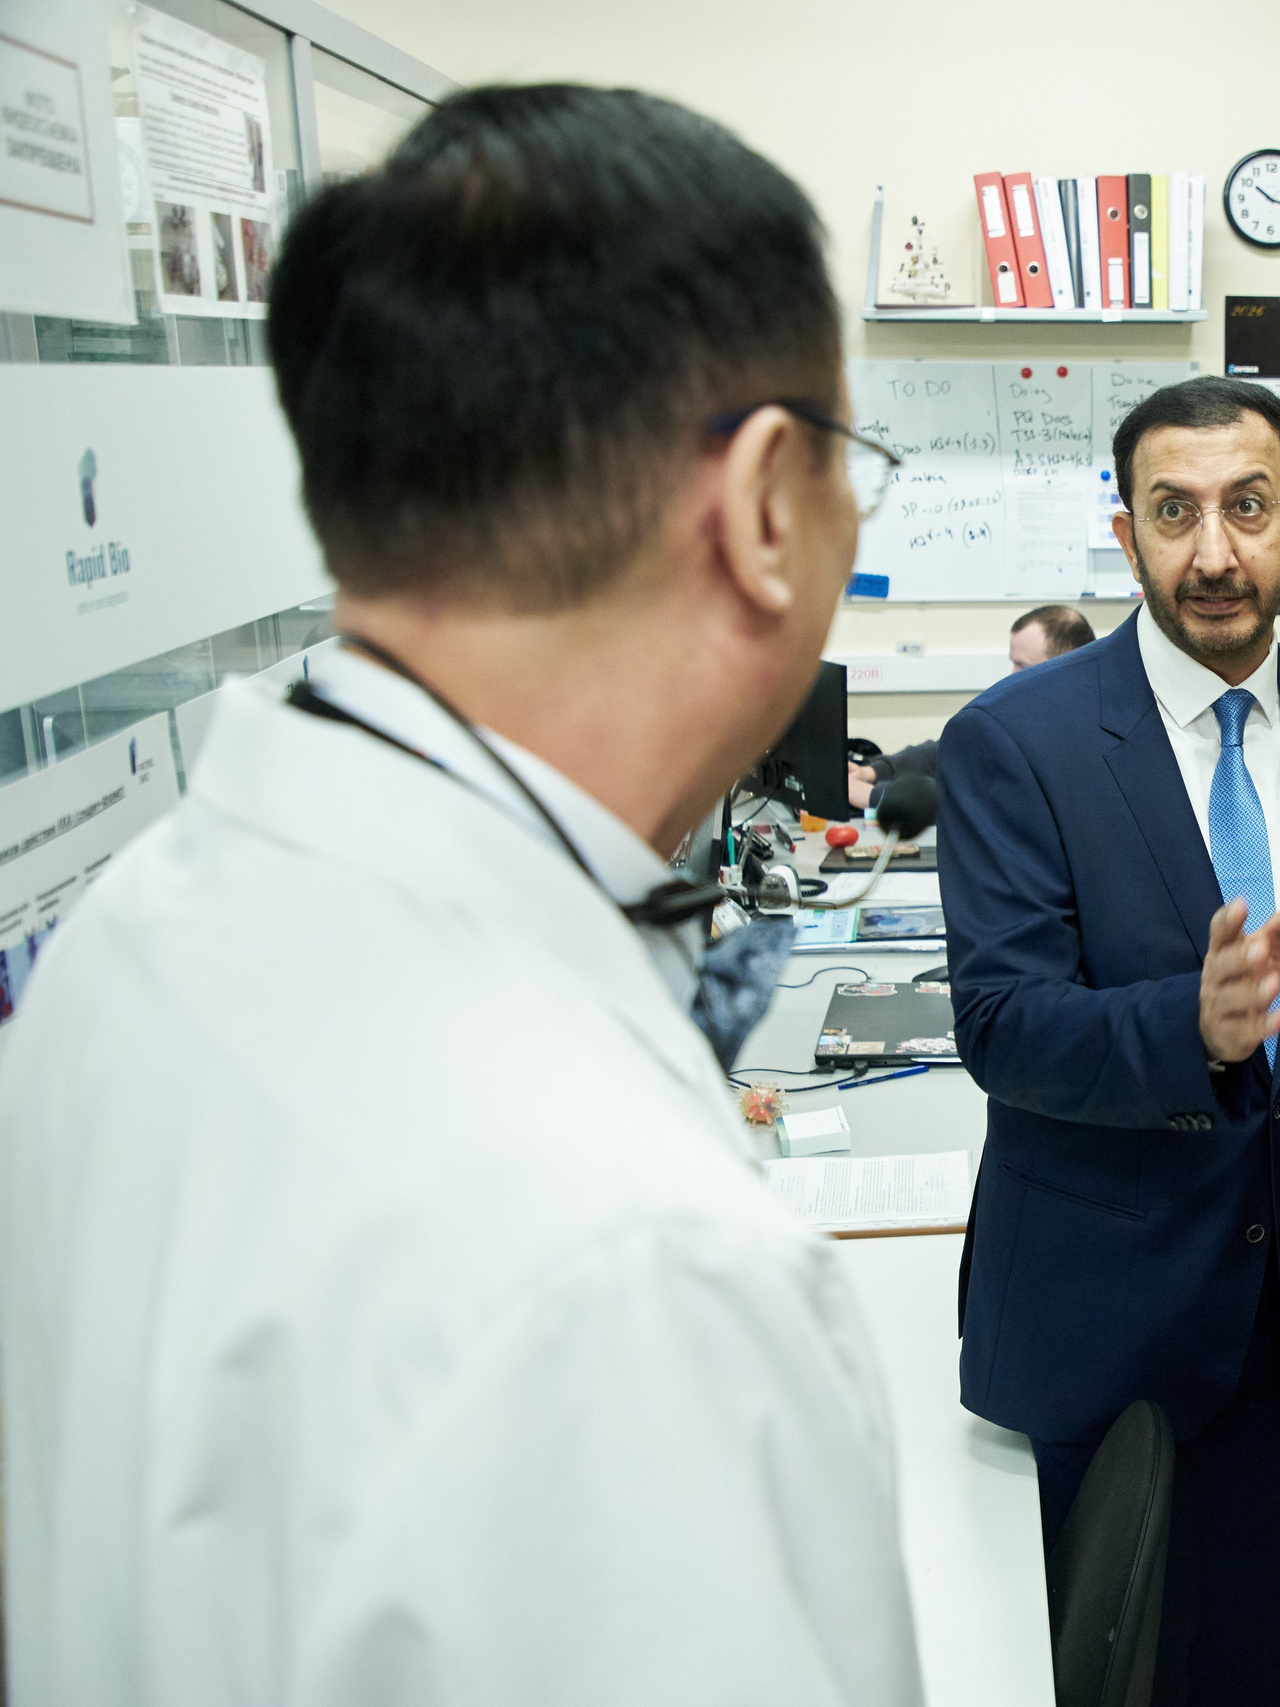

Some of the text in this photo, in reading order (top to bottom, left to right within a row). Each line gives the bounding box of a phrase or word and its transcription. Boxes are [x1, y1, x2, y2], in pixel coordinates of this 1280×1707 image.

[1252, 167, 1261, 177] 11
[1265, 163, 1278, 173] 12
[1241, 178, 1254, 188] 10
[1237, 194, 1245, 204] 9
[1241, 209, 1249, 219] 8
[1251, 221, 1260, 231] 7
[1266, 225, 1275, 236] 6
[1230, 305, 1267, 317] 2026
[888, 379, 951, 401] TO DO
[1009, 383, 1053, 405] Doing
[65, 541, 130, 591] Rapid Bio
